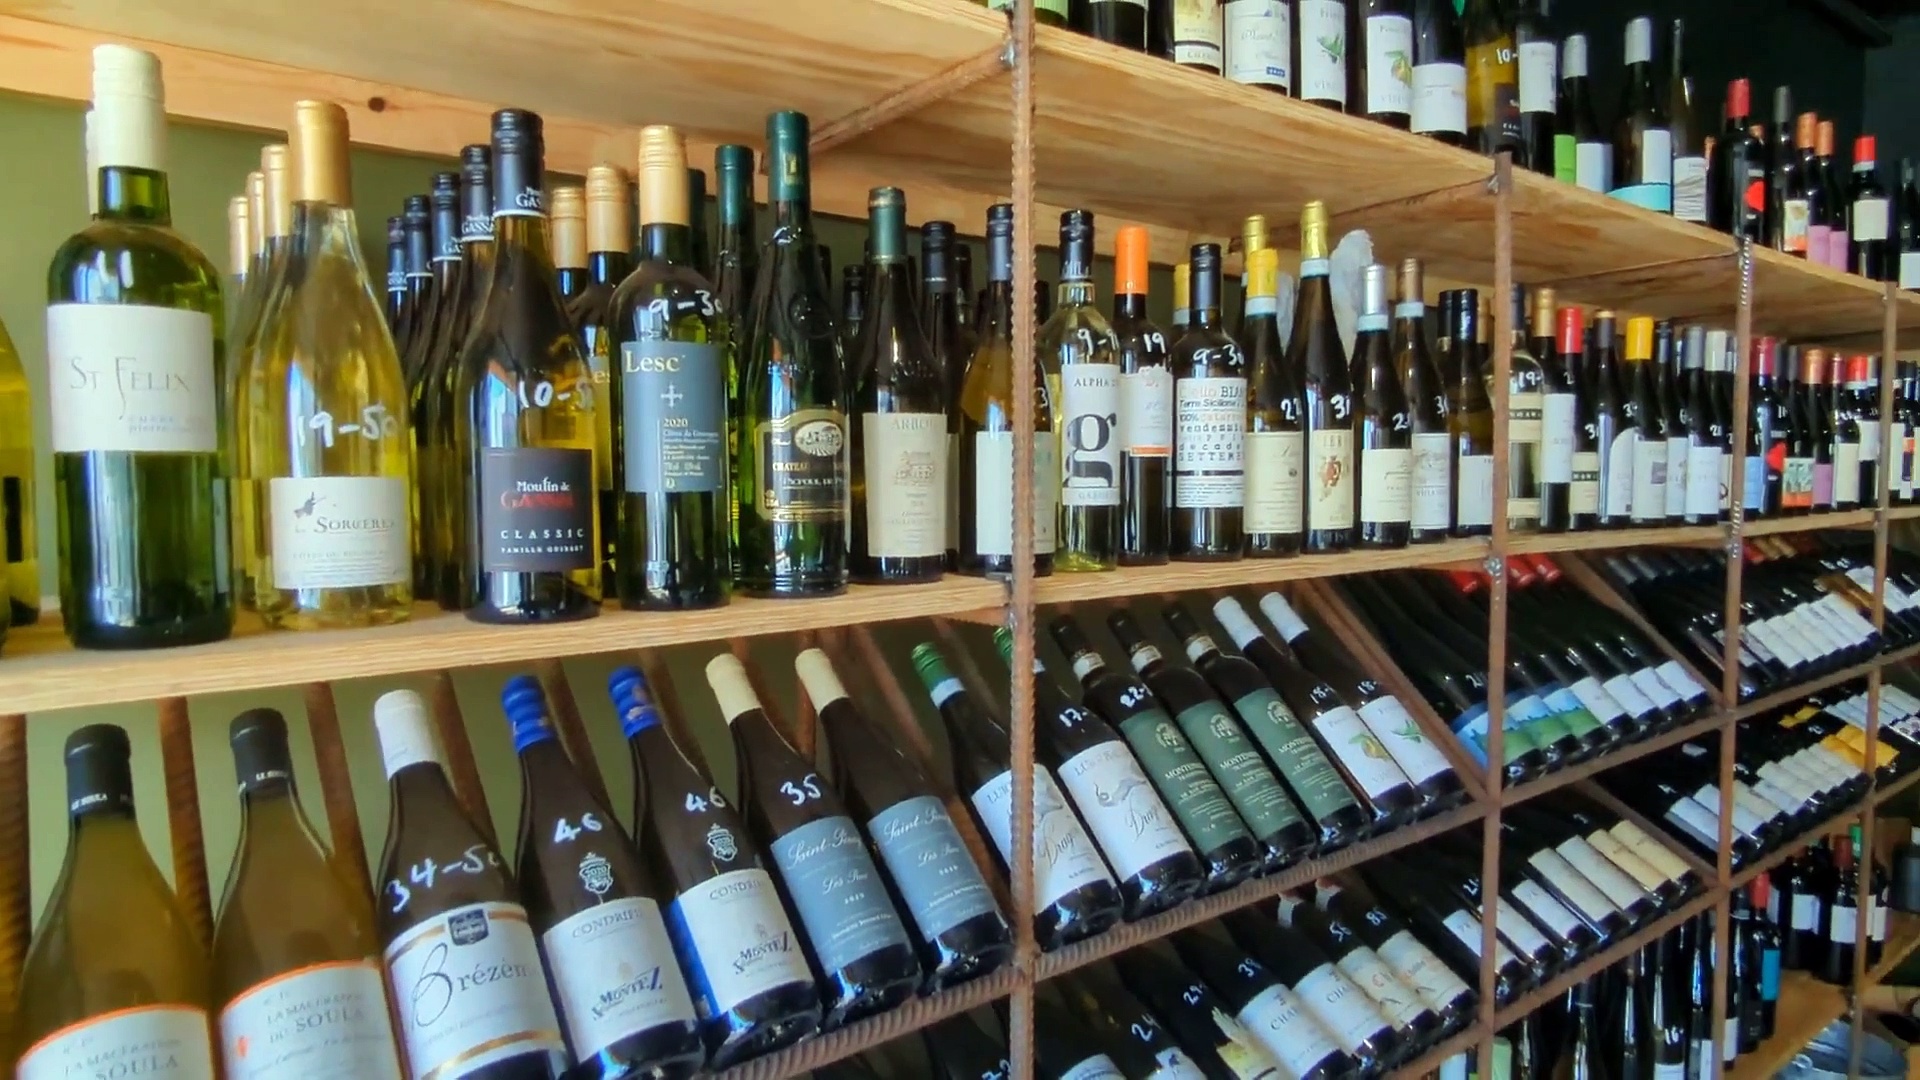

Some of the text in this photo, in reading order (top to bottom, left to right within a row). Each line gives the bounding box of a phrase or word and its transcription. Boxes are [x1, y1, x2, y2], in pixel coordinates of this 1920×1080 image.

[1063, 413, 1117, 488] g
[501, 529, 584, 539] CLASSIC
[780, 773, 821, 806] 35
